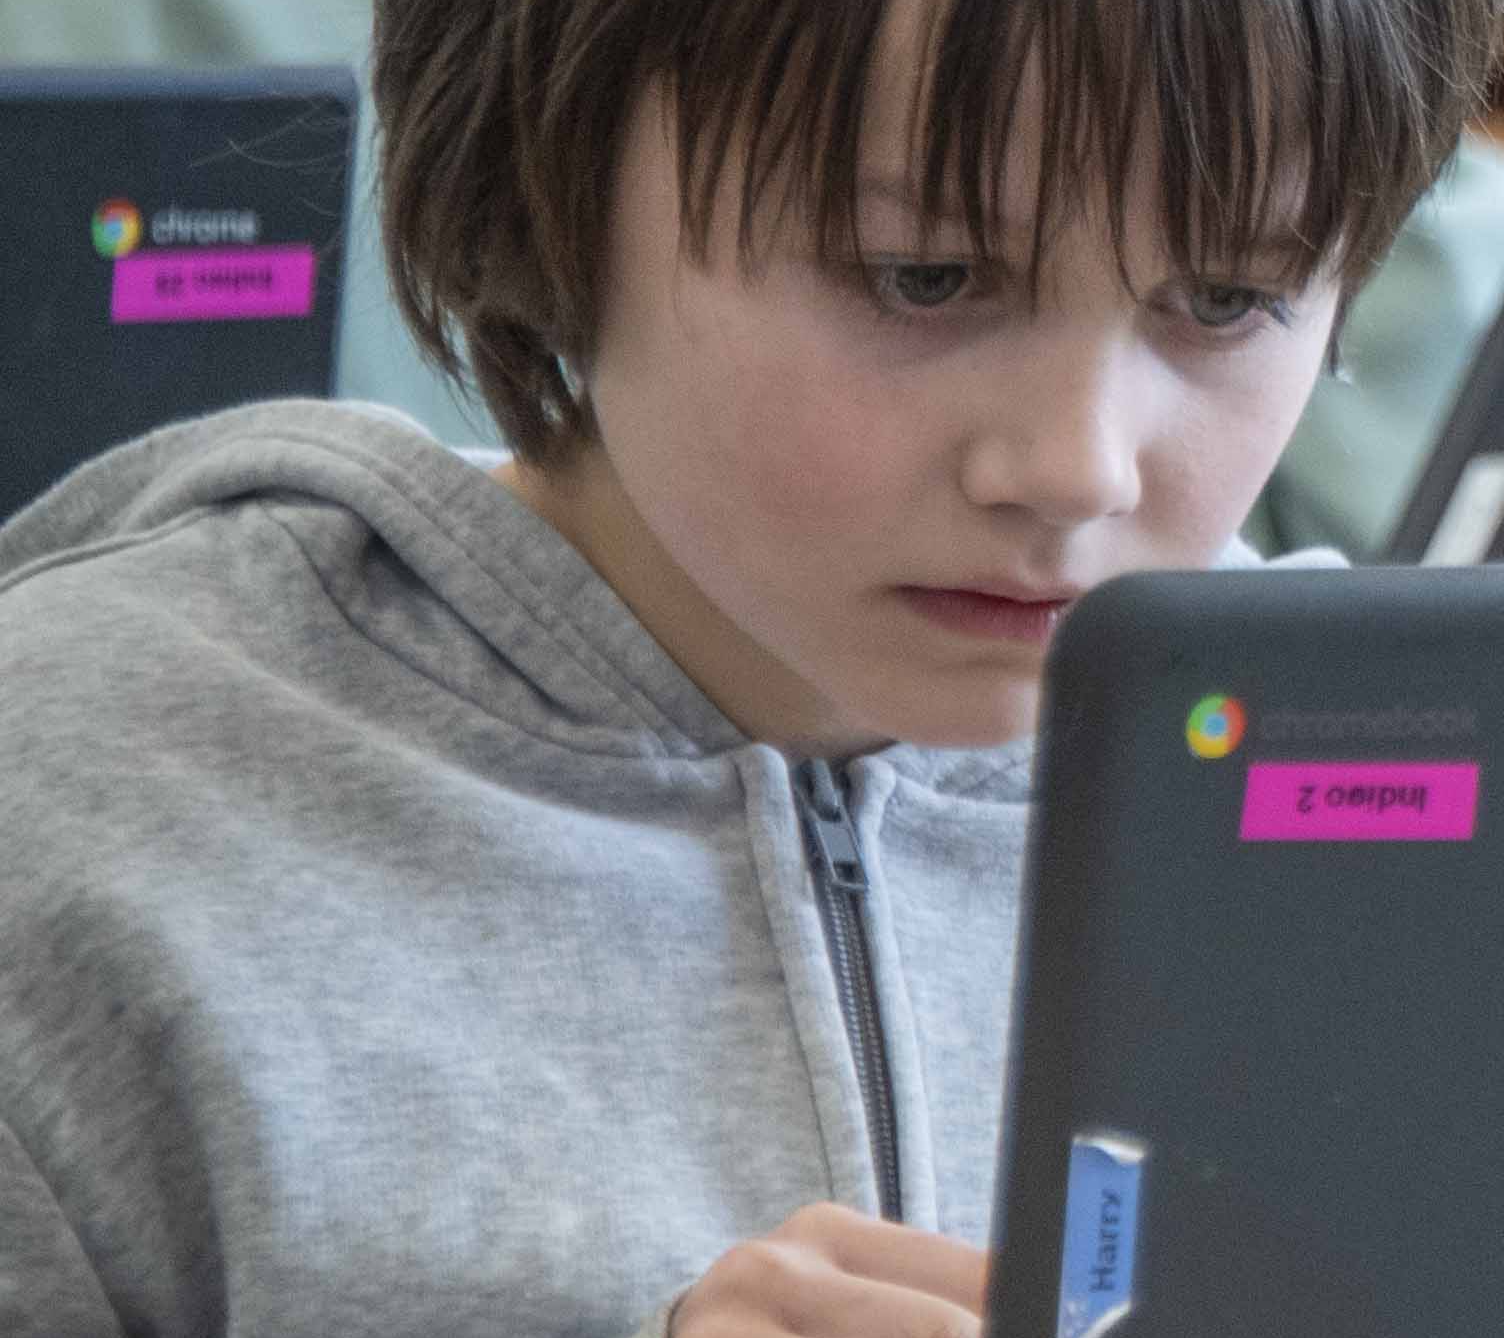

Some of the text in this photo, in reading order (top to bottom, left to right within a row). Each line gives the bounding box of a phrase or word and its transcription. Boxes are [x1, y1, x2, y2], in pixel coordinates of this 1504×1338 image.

[1258, 704, 1479, 740] chromebook
[1296, 784, 1315, 815] 2
[1089, 1188, 1121, 1292] Harry
